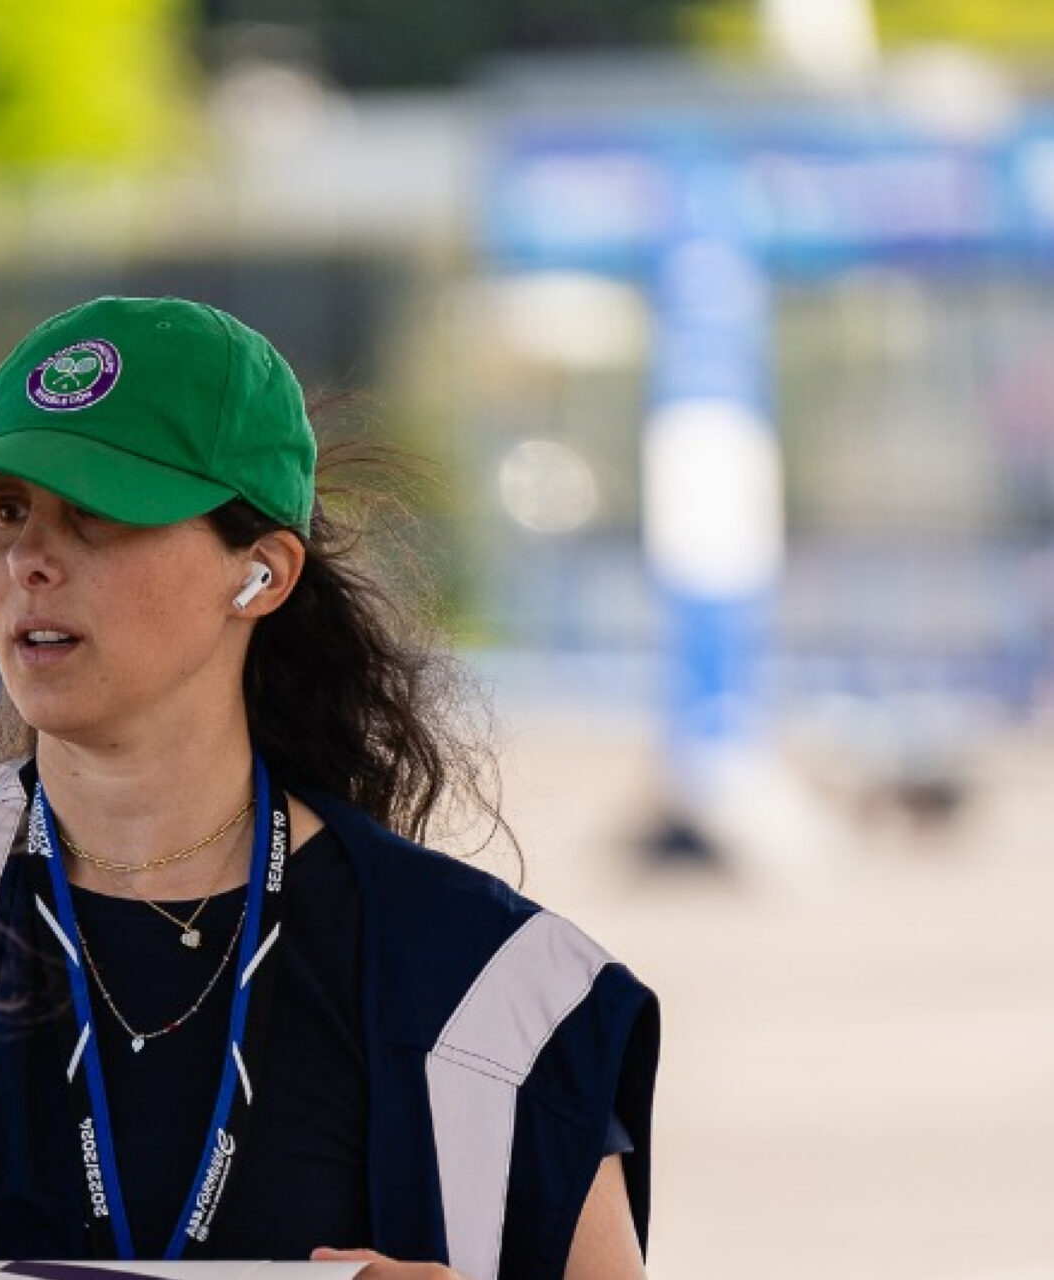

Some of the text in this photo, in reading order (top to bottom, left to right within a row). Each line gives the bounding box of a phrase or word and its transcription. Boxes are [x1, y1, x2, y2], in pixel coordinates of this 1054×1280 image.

[266, 810, 287, 892] SEASON 10
[79, 1116, 109, 1218] 2023/2024
